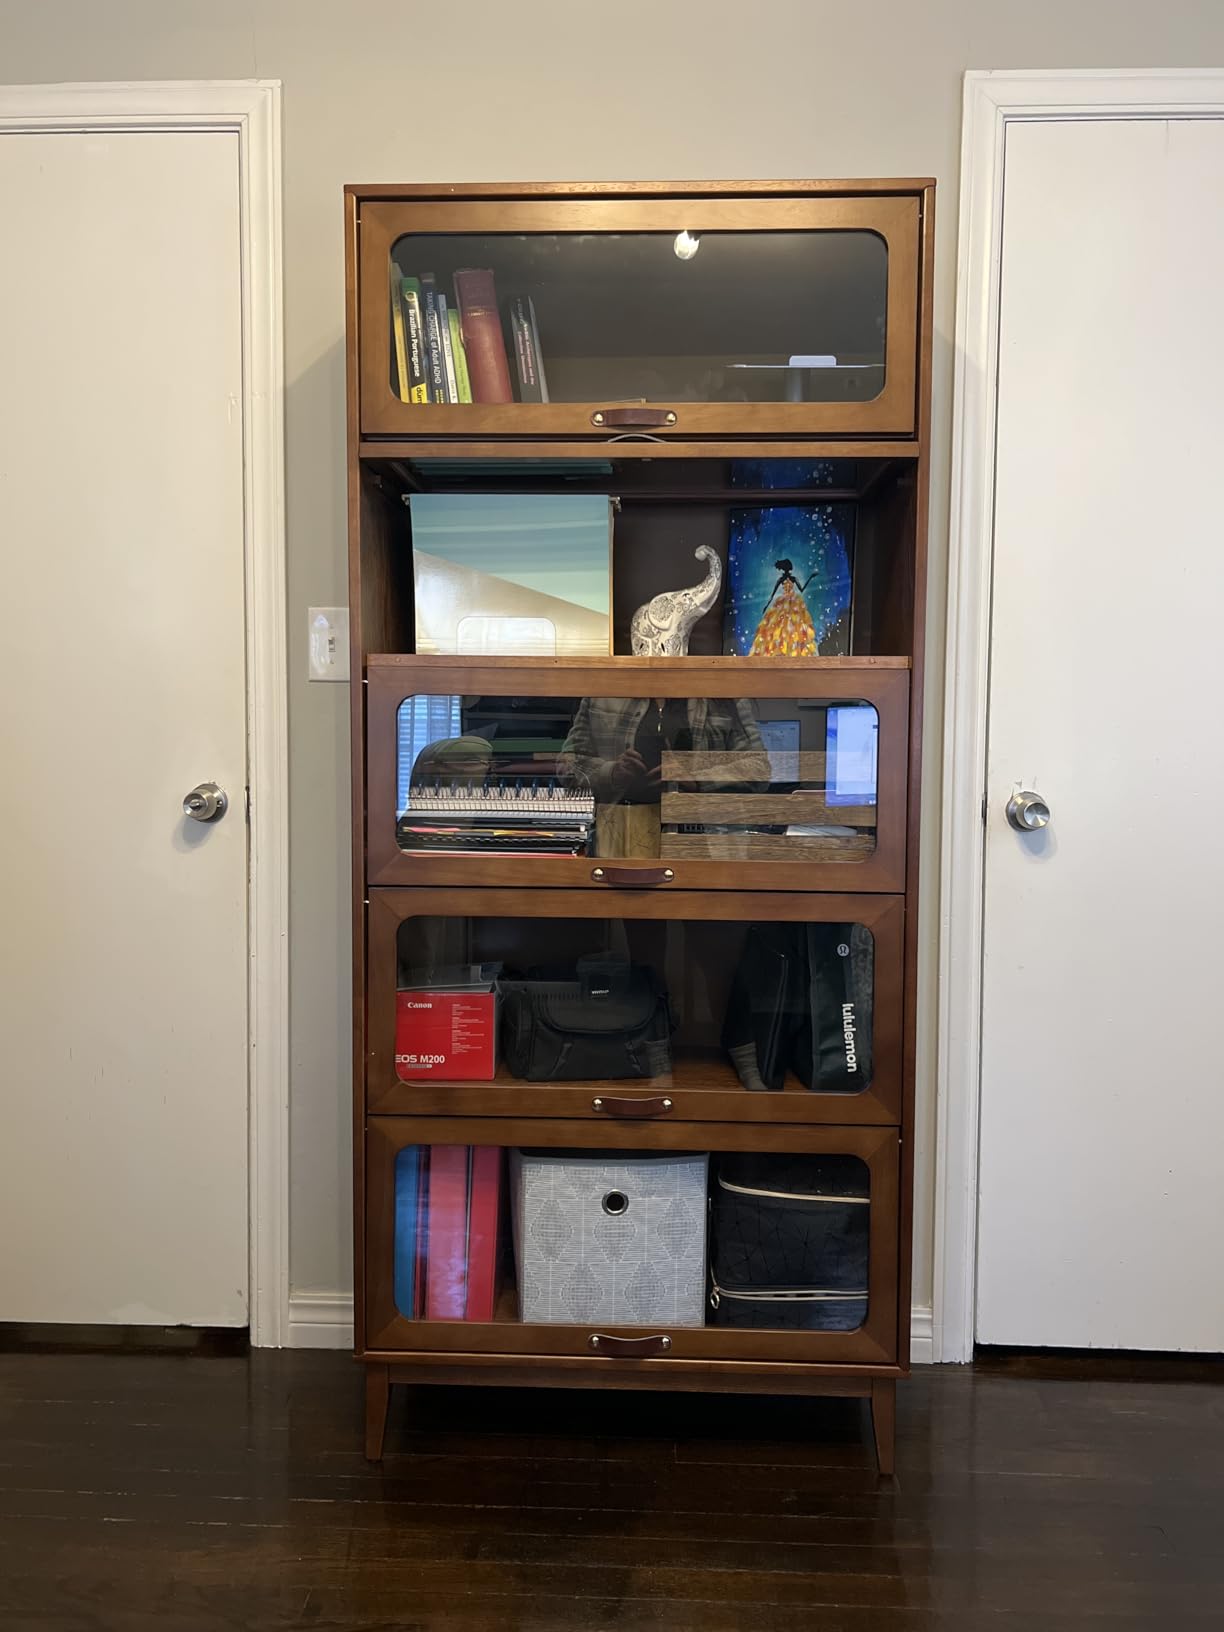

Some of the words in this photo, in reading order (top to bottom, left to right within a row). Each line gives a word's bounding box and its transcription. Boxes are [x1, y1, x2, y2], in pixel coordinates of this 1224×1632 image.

[426, 292, 434, 315] TAKING
[408, 309, 417, 338] Brazilian
[428, 316, 437, 341] CHARGE
[411, 339, 420, 378] Portuguese
[432, 349, 440, 365] Adult
[433, 366, 442, 384] ADHD
[842, 1003, 857, 1073] lululemon
[396, 1054, 418, 1063] EOS
[420, 1055, 446, 1064] M200
